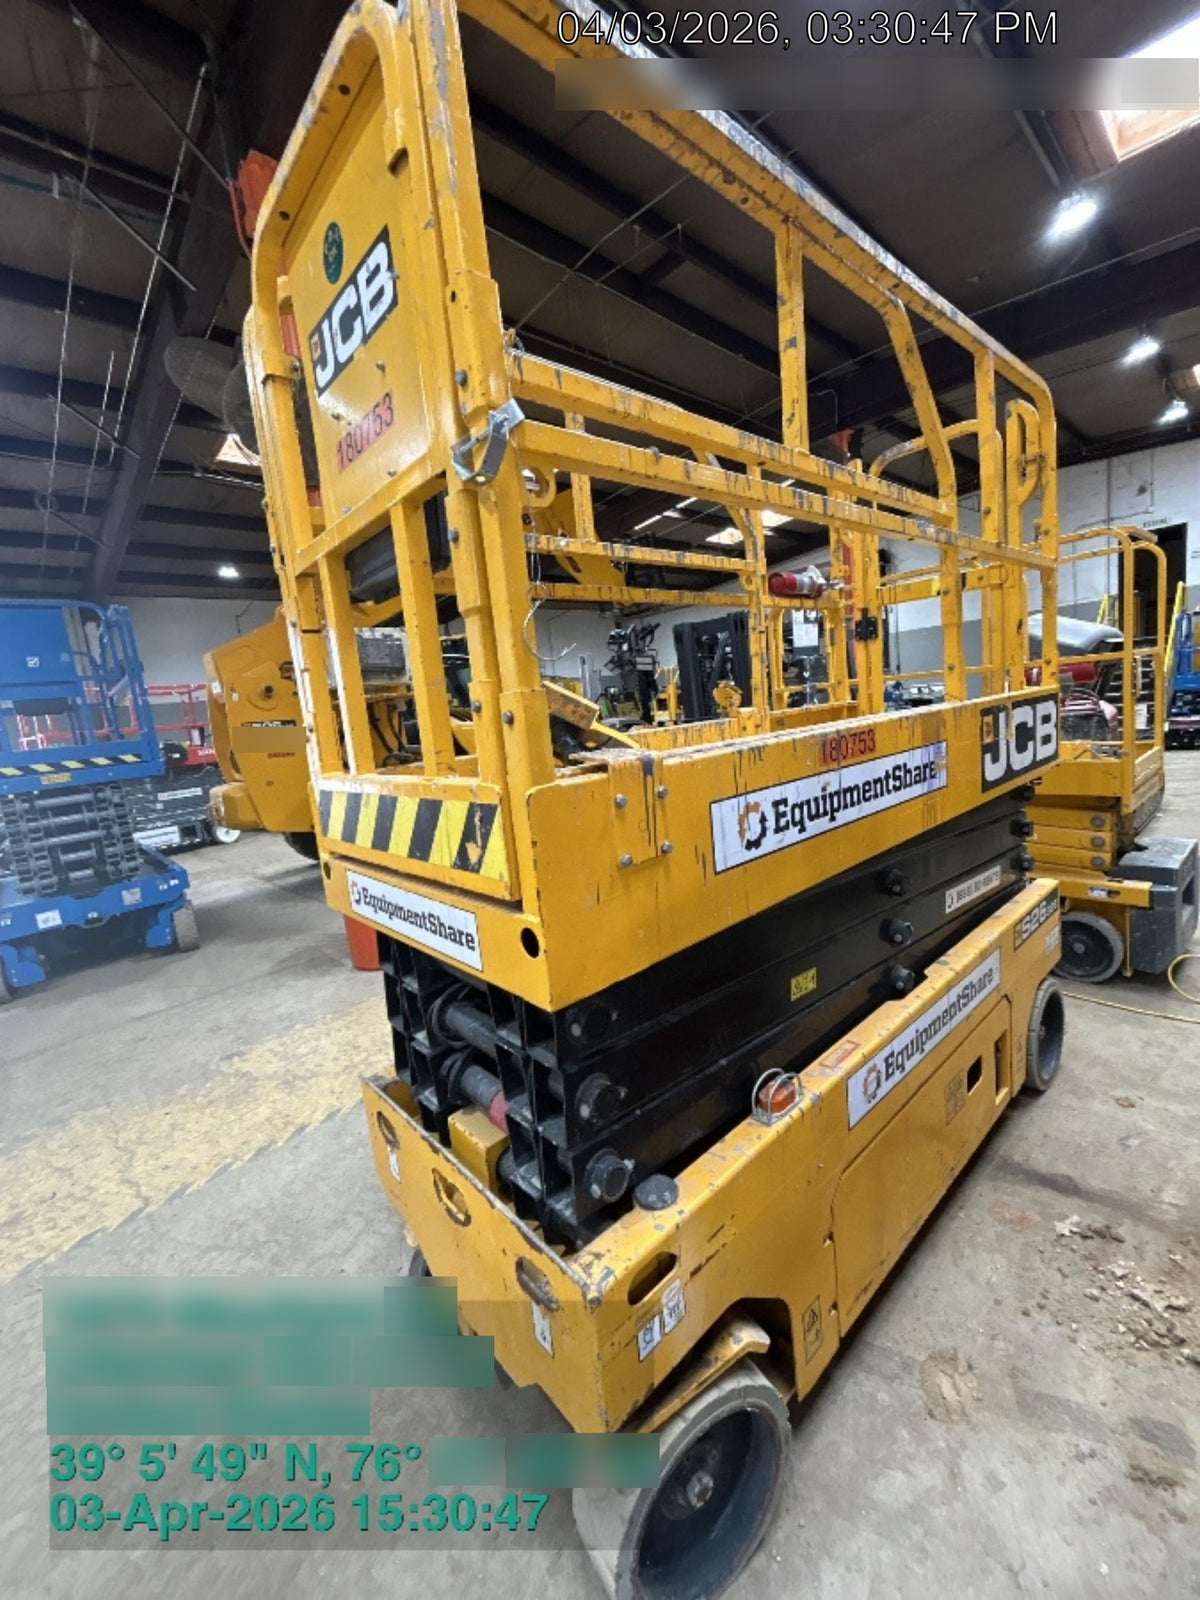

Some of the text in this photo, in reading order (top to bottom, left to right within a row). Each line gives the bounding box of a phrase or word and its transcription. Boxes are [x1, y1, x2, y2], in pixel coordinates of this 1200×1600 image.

[316, 241, 394, 389] JCB
[336, 392, 394, 467] 180753
[820, 728, 877, 764] 180753
[984, 699, 1058, 782] JCB
[772, 760, 938, 834] EquipmentShare
[361, 886, 476, 952] EquipmentShare
[883, 966, 994, 1083] EquipmentShare
